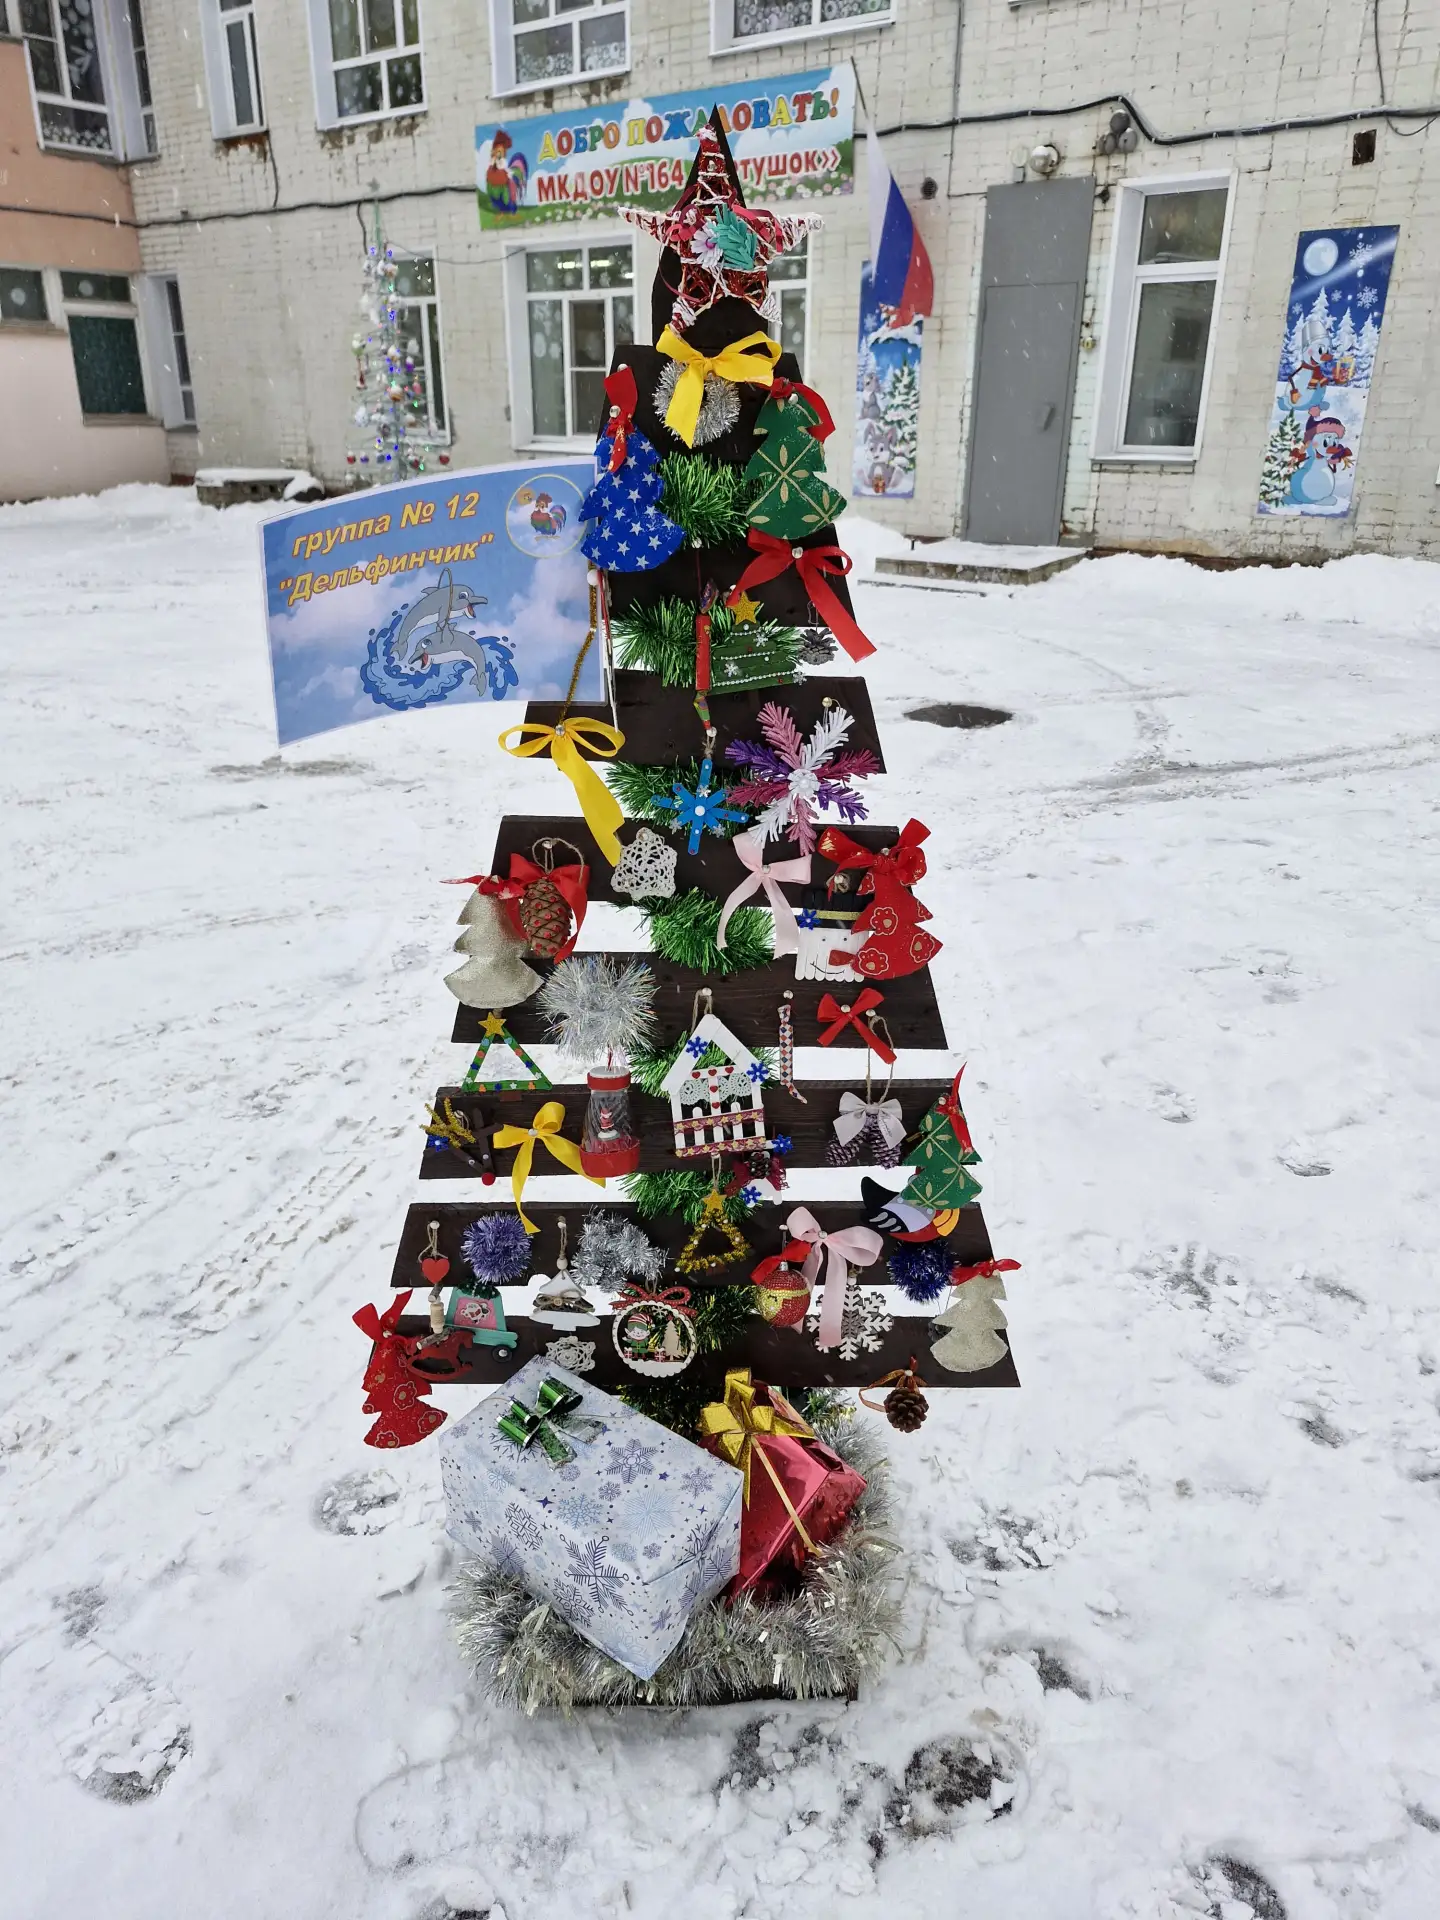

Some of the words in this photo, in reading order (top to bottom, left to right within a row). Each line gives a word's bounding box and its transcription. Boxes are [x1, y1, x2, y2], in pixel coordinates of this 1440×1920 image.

[538, 122, 620, 163] ДОБРО
[536, 167, 620, 203] МКДОУ
[291, 513, 392, 560] группа
[400, 500, 436, 530] №
[446, 491, 481, 520] 12
[279, 532, 495, 607] "Дельфинчик"
